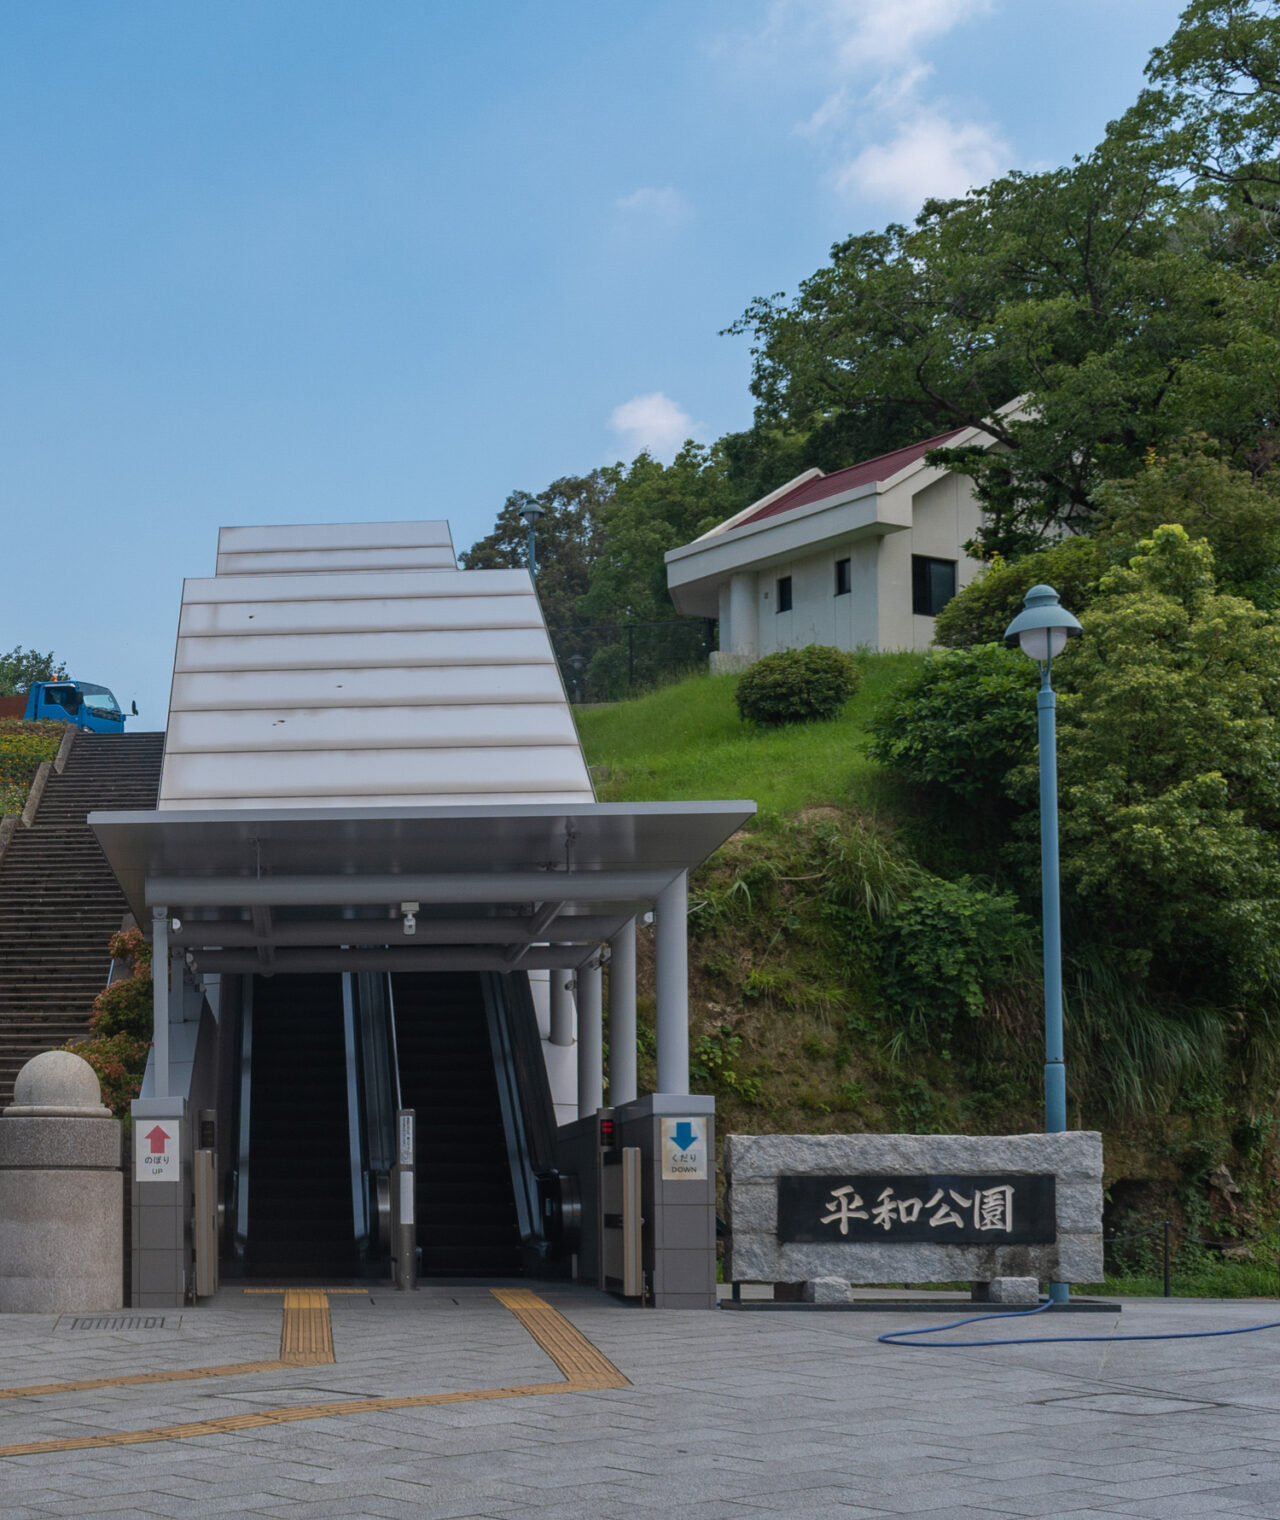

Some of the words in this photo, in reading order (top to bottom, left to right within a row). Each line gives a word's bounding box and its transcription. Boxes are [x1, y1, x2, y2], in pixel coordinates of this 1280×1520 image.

[144, 1155, 170, 1165] のぼり
[672, 1154, 697, 1163] くだり
[820, 1184, 1015, 1235] 平和公園
